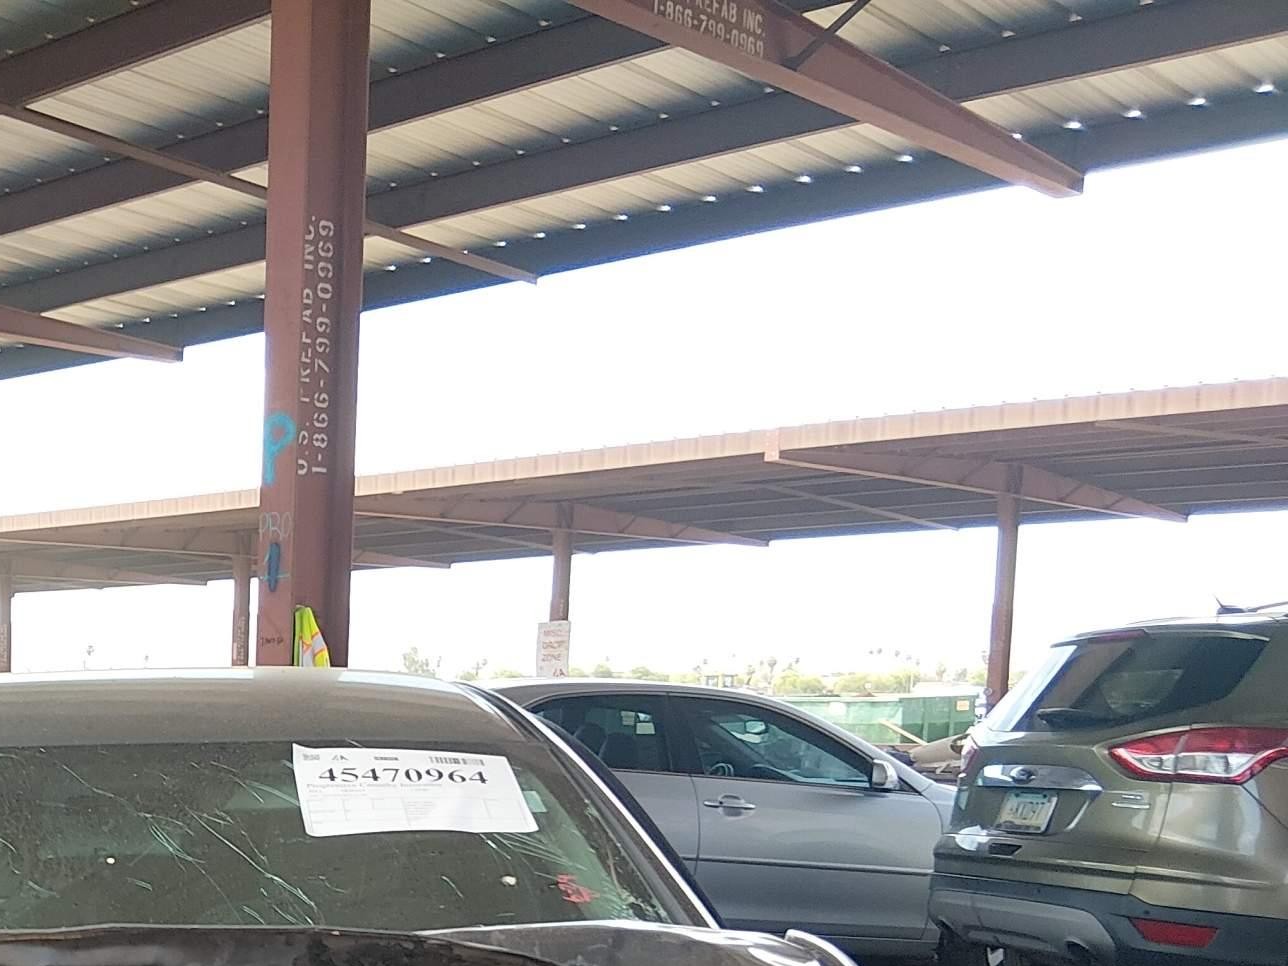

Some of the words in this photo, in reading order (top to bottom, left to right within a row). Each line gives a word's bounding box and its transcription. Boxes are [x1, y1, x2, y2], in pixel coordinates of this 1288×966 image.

[742, 8, 766, 37] INC.
[311, 219, 335, 473] 1-866-799-0969
[318, 767, 488, 785] 45470964
